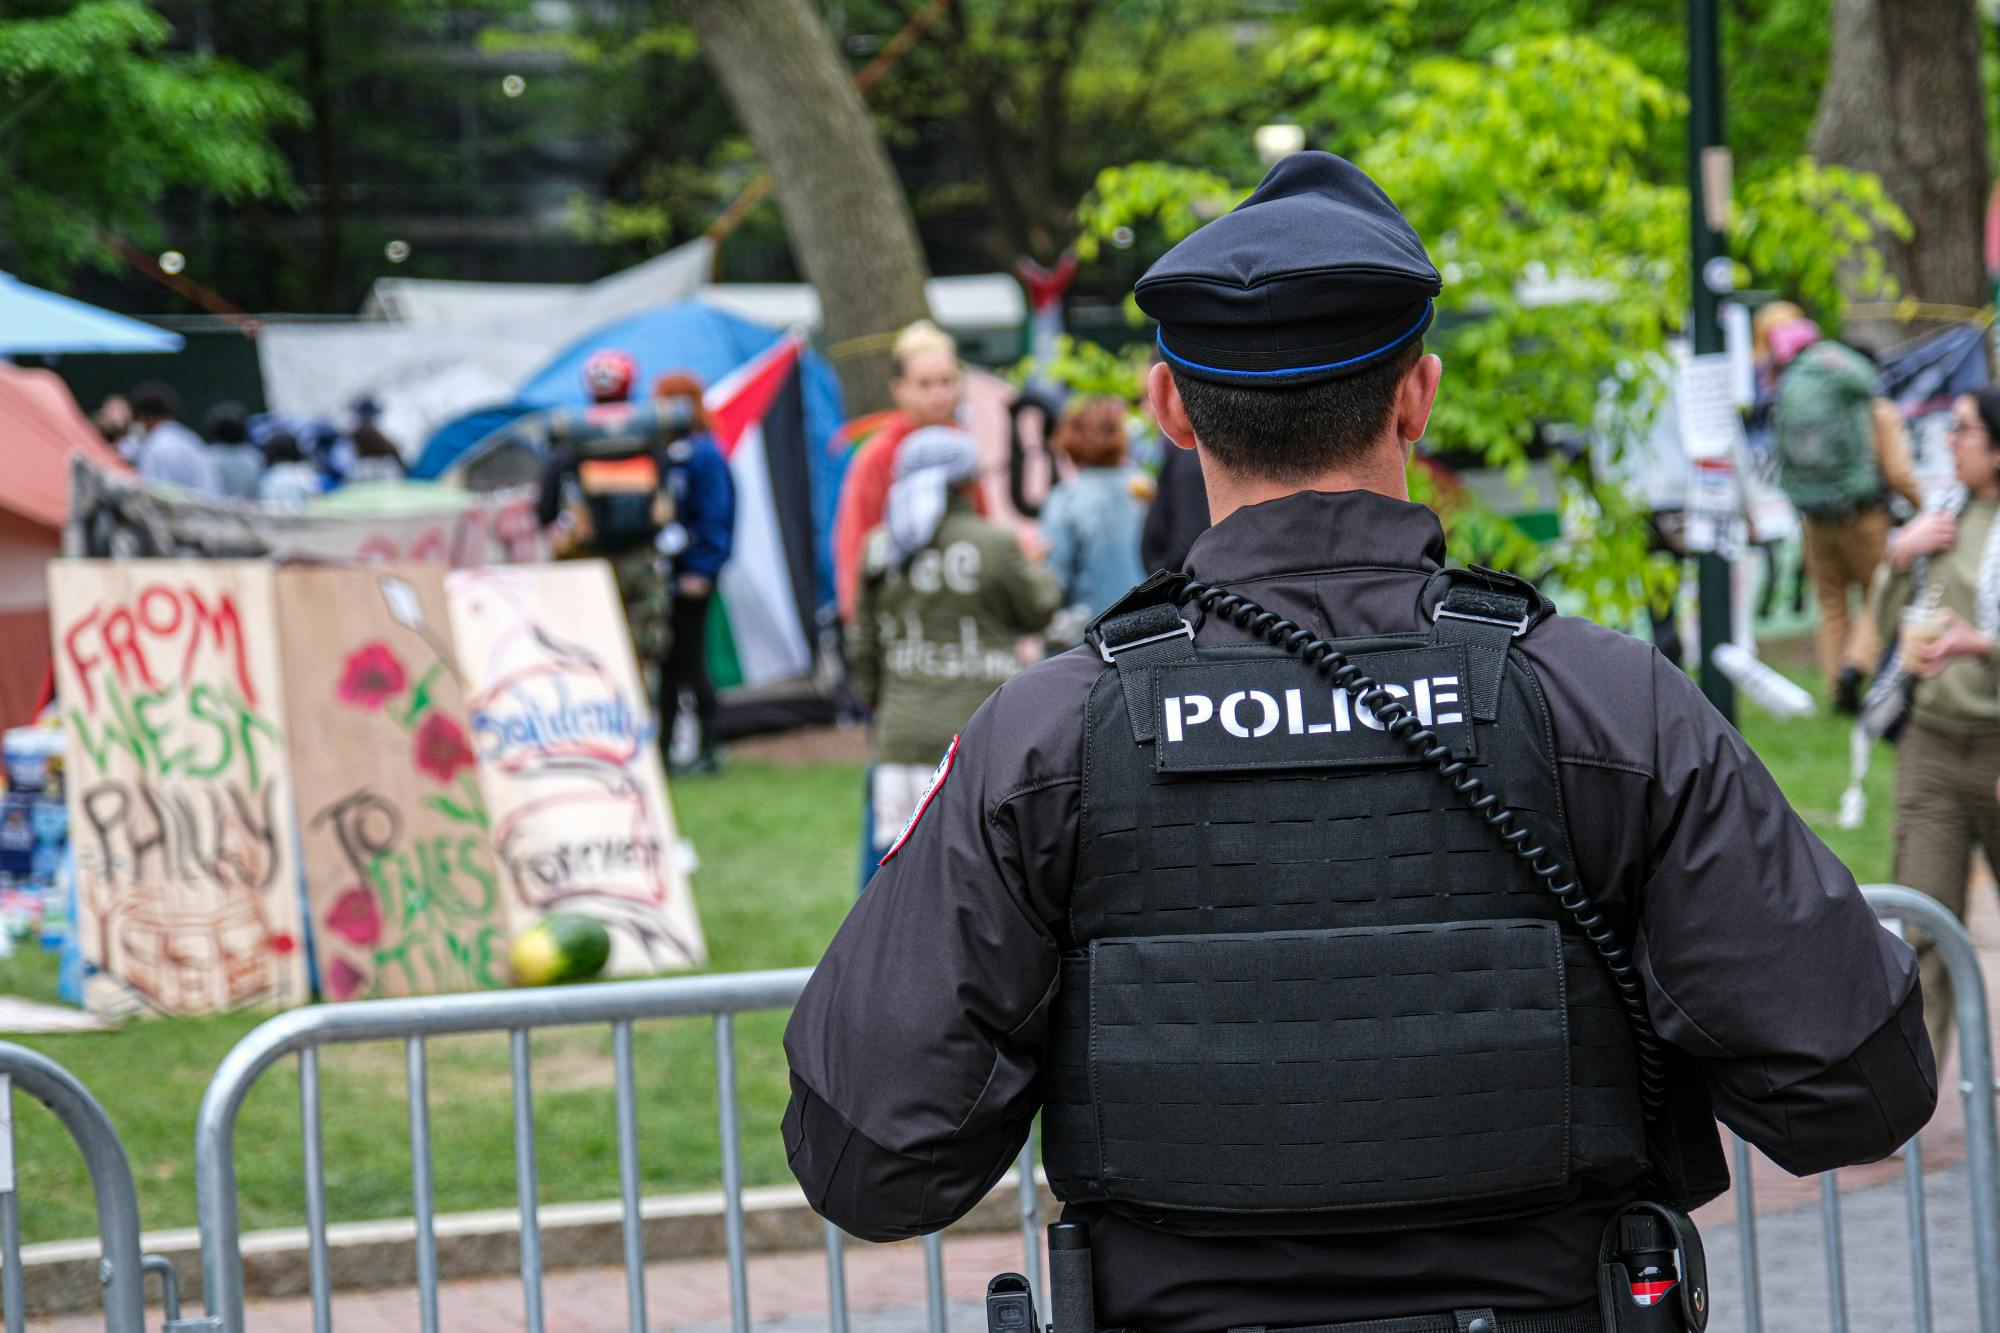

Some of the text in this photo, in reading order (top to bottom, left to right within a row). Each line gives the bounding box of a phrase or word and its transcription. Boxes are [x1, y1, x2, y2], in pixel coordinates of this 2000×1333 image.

[65, 584, 258, 714] FROM
[70, 672, 283, 792] WEST
[1164, 676, 1463, 742] POLICE
[307, 788, 402, 895] TO
